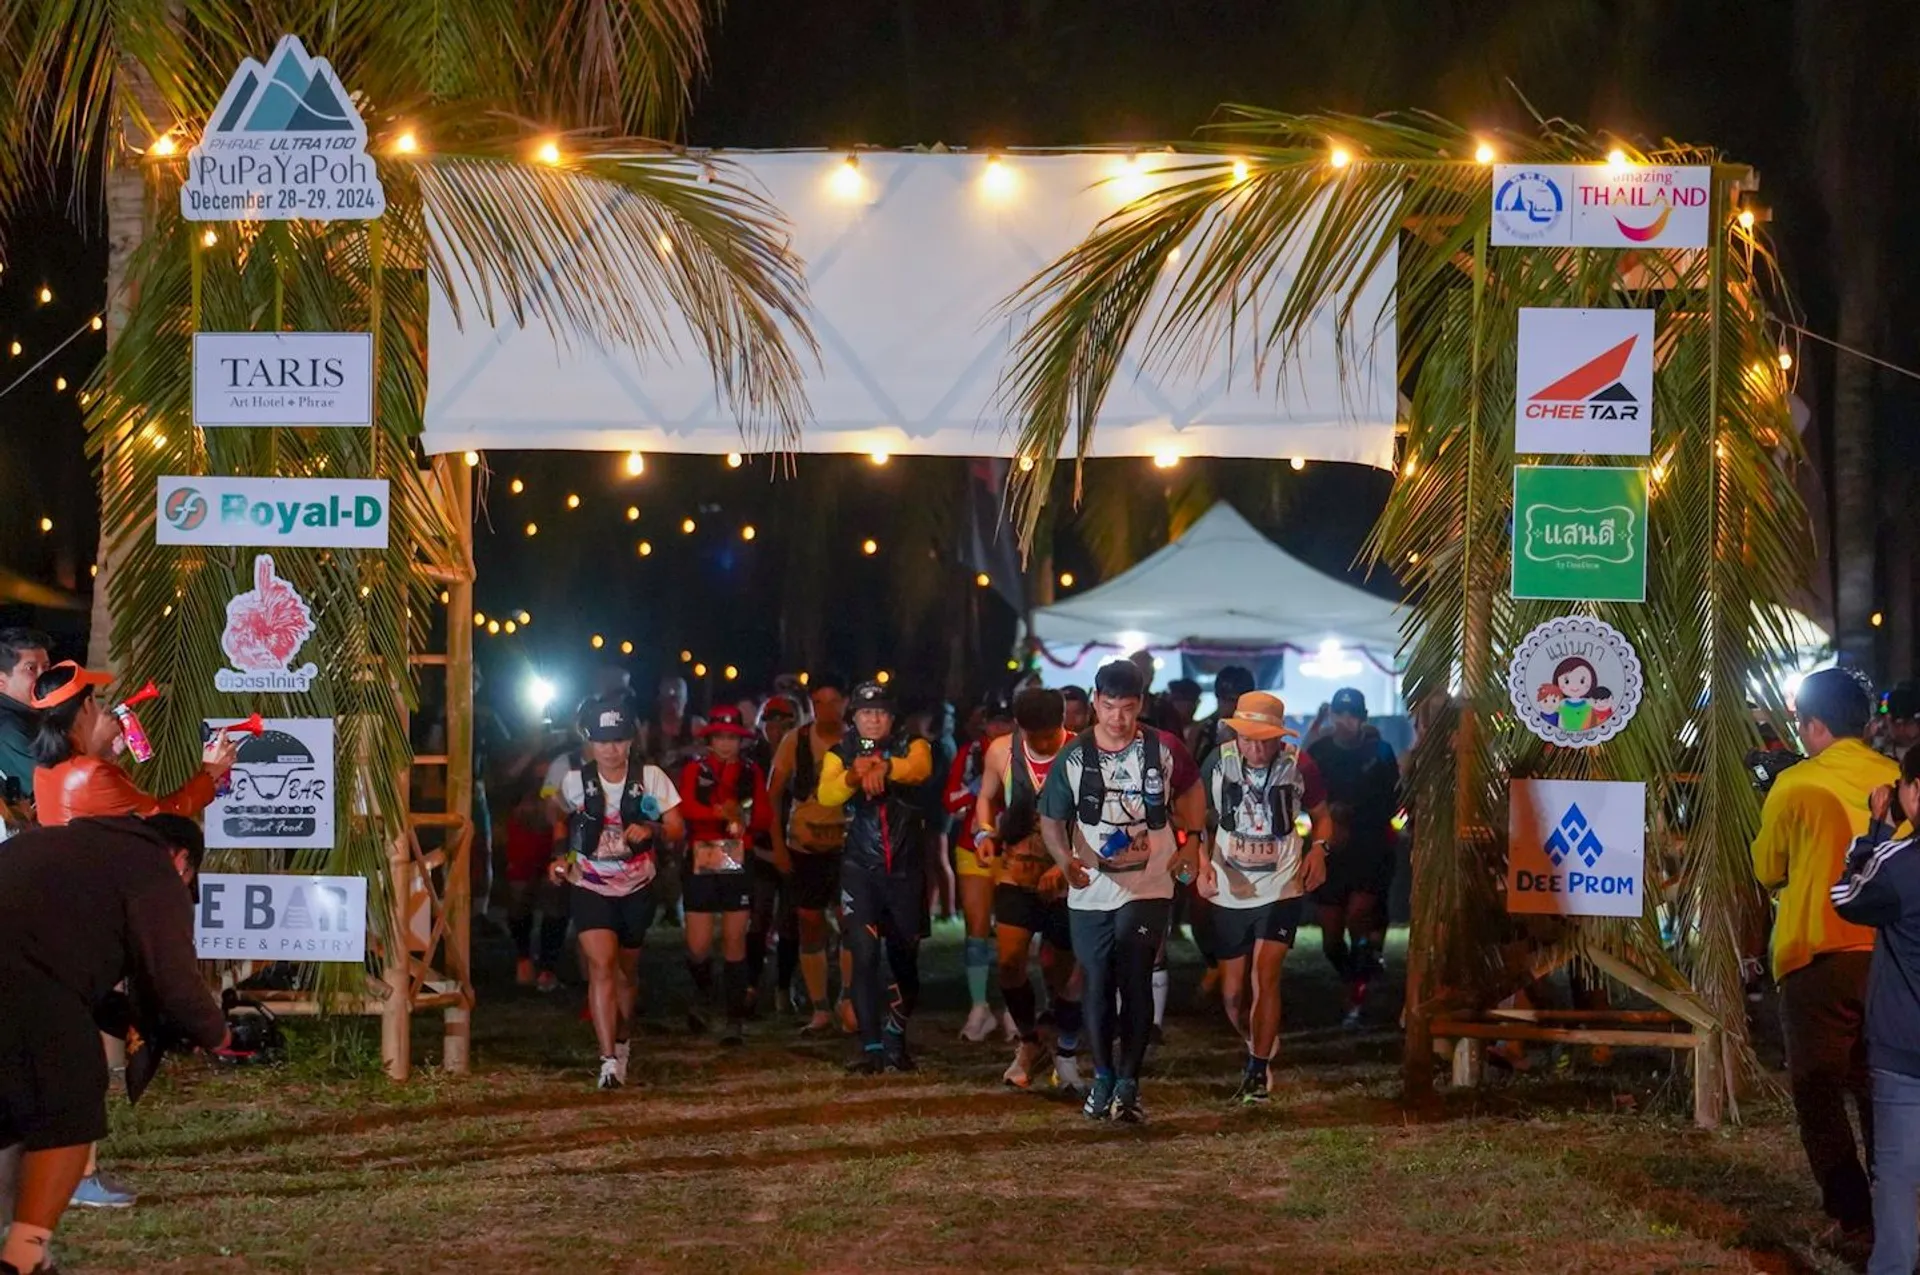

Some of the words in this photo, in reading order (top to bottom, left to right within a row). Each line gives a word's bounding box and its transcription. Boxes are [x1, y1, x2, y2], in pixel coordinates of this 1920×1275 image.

[200, 154, 366, 185] PuPaYaPoh
[1613, 169, 1673, 186] amazing
[191, 190, 273, 210] December
[336, 188, 375, 209] 2024
[1579, 187, 1707, 207] THAILAND
[221, 358, 344, 388] TARIS
[230, 396, 248, 408] Art
[252, 396, 285, 408] Hotel
[298, 396, 335, 408] Phrae
[220, 493, 382, 535] Royal-D
[1544, 518, 1616, 546] แสนดี
[289, 778, 326, 801] BAR
[275, 820, 304, 835] Food
[244, 884, 350, 932] BAR
[258, 938, 268, 950] &
[280, 938, 354, 951] PASTRY
